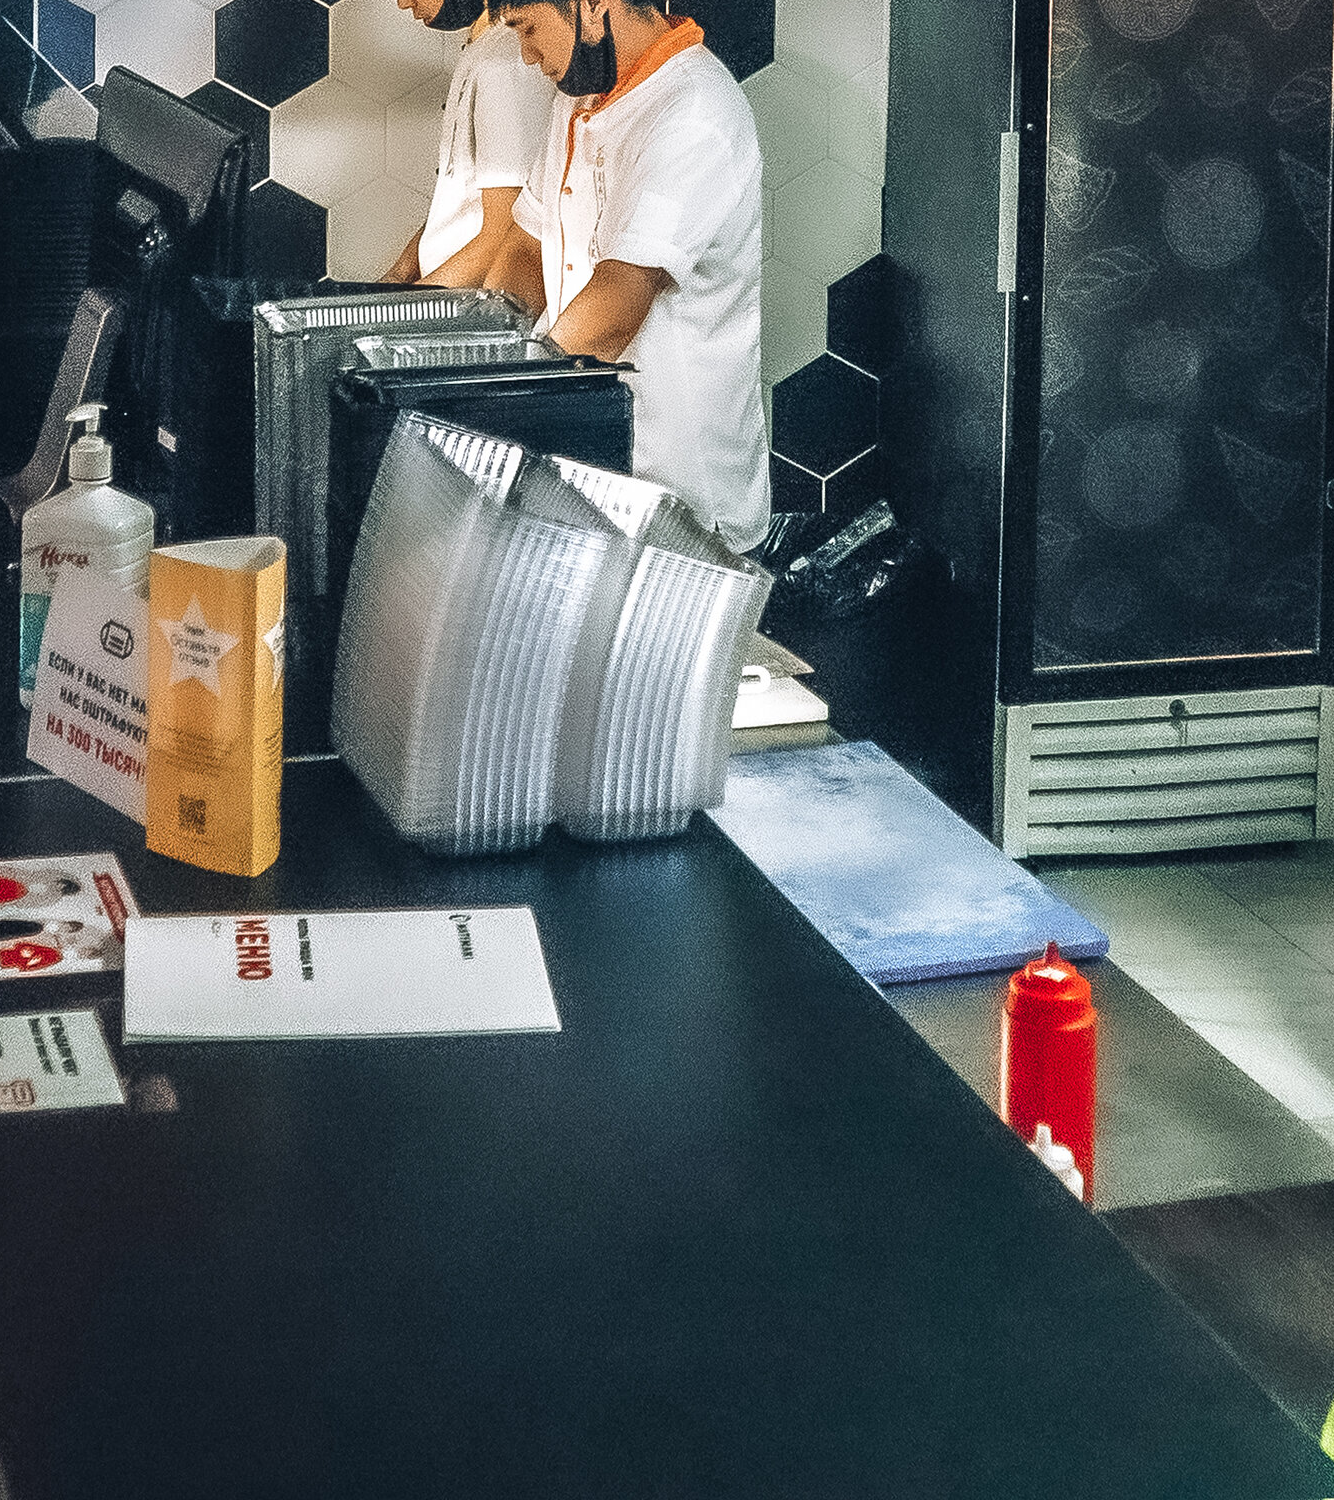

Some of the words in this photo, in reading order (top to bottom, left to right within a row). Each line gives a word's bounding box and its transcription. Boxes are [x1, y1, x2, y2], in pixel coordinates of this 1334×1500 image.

[48, 650, 75, 678] ЕСЛИ
[77, 667, 85, 682] У
[85, 671, 107, 695] ВАС
[108, 683, 130, 707] НЕТ
[59, 686, 81, 710] НАС
[45, 712, 64, 739] НА
[67, 723, 91, 754] 300
[235, 918, 274, 982] МЕНЮ
